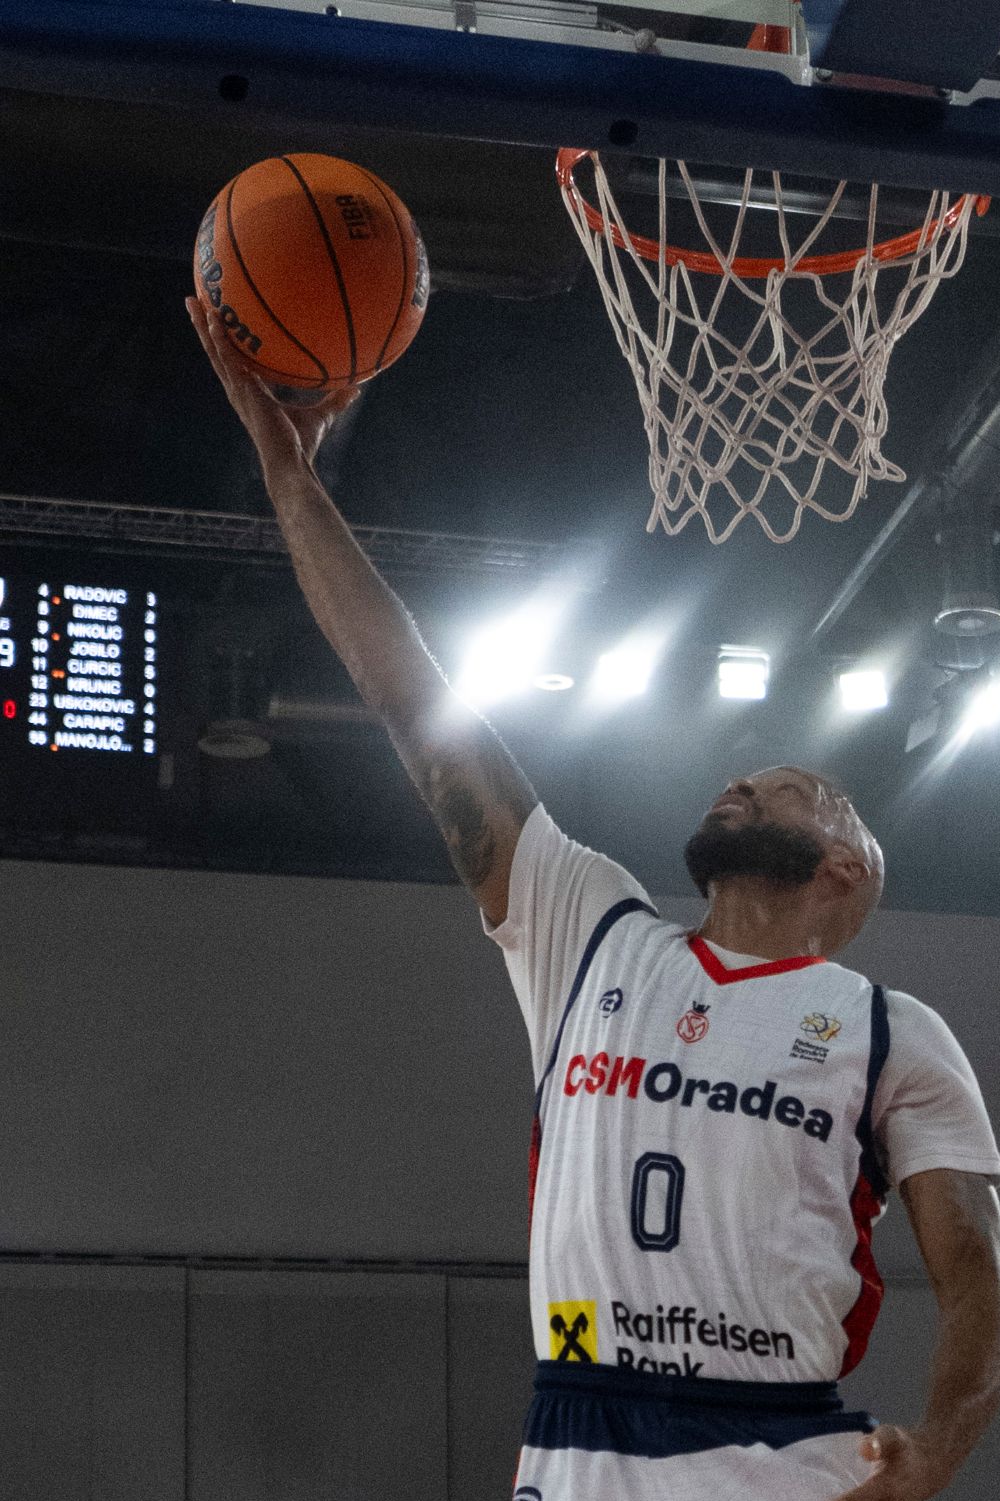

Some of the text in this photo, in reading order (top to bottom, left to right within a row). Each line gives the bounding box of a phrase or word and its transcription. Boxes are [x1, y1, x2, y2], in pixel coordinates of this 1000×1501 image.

[64, 585, 127, 604] RADOVIC
[72, 603, 118, 621] DIMEC
[67, 621, 122, 641] NIKOLIC
[31, 638, 49, 653] 10
[32, 656, 47, 671] 11
[31, 674, 48, 690] 12
[67, 677, 121, 695] KRUNIC
[54, 694, 135, 714] USKOKOVIC
[28, 711, 47, 726] 44
[631, 1152, 685, 1252] 0
[611, 1301, 796, 1360] Raiffeisen
